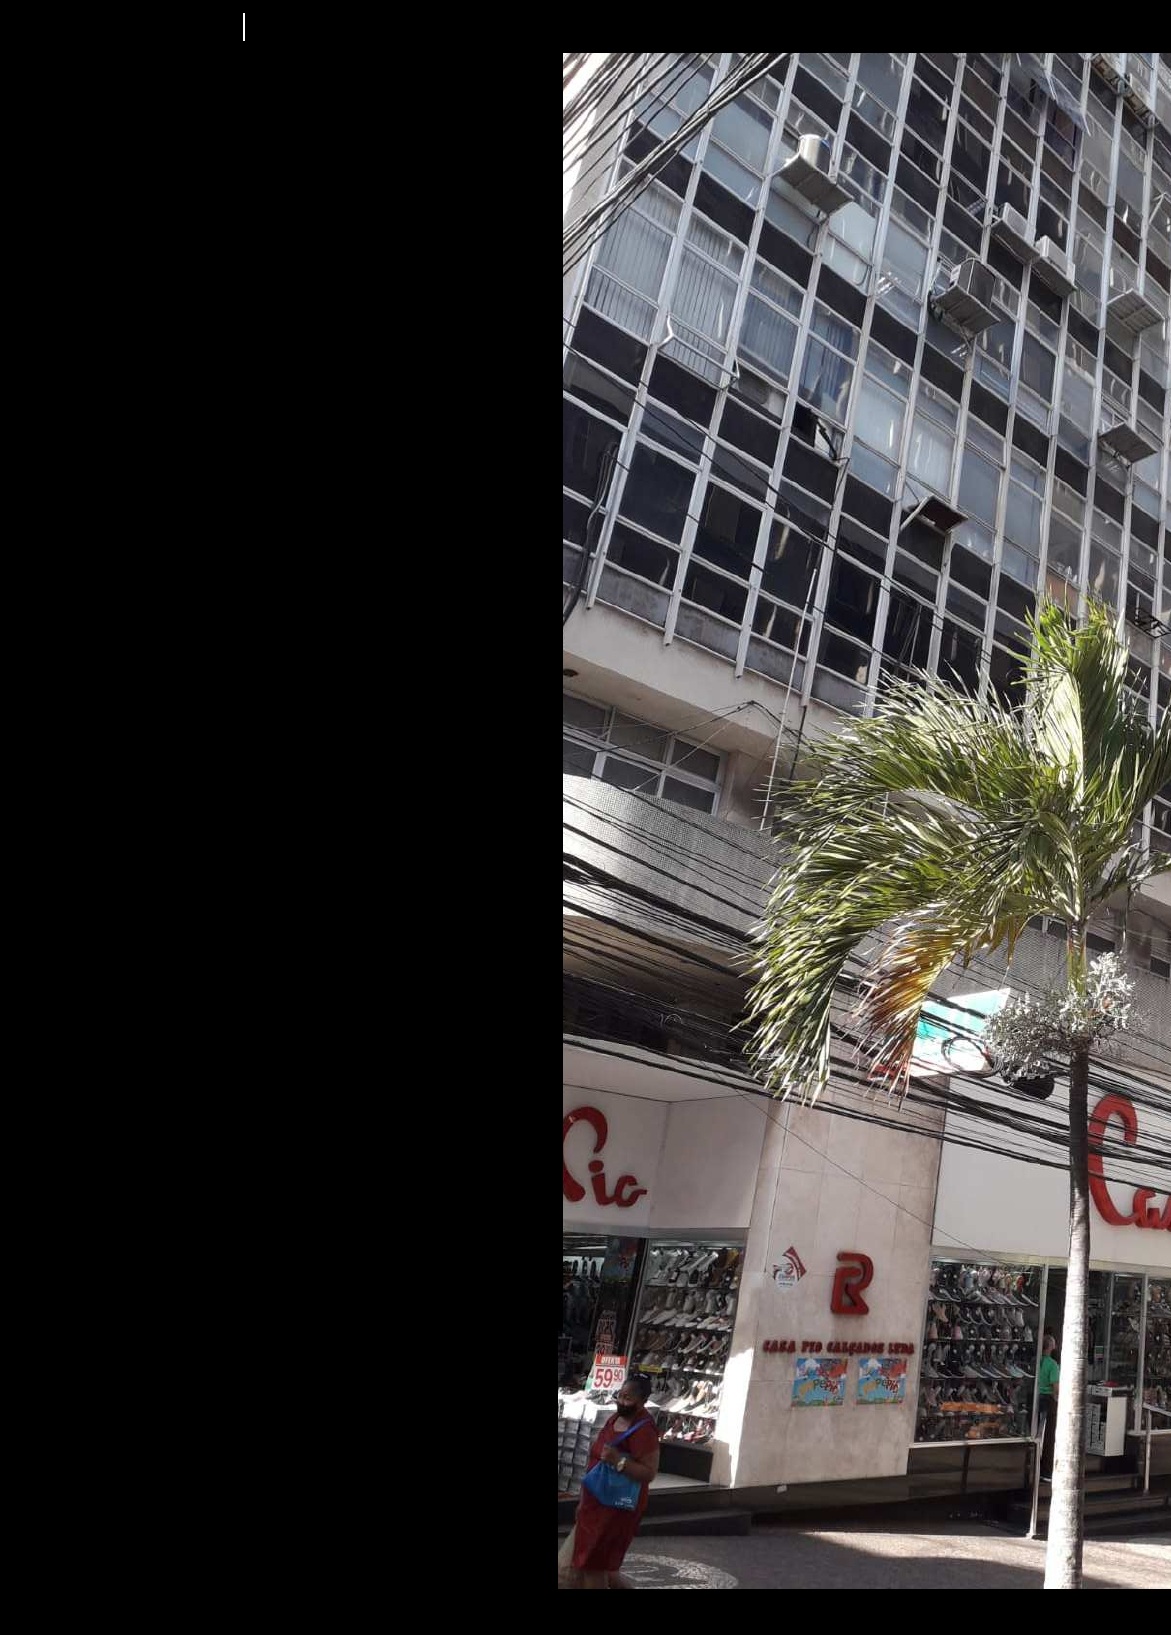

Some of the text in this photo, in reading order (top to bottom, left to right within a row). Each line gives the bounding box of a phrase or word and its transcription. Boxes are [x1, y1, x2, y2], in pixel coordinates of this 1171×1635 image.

[763, 1340, 915, 1356] CASA PIO CALÇADOS LTDA
